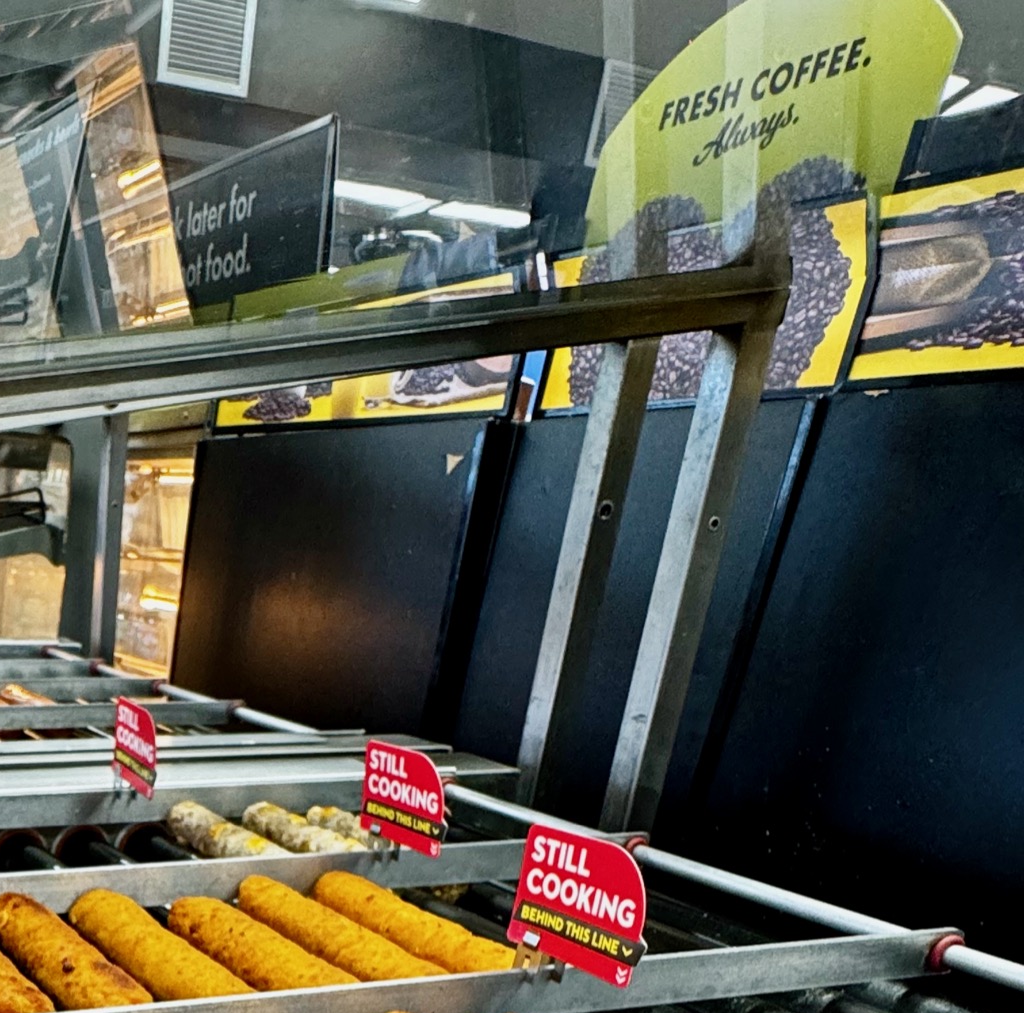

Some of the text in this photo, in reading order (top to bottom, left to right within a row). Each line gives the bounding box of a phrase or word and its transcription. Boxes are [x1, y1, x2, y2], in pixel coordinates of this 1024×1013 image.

[658, 37, 871, 131] FRESH COFFEE.
[692, 103, 800, 167] Always.
[186, 200, 227, 238] later
[228, 182, 257, 224] for
[205, 232, 251, 283] food.
[118, 704, 140, 732] STILL
[116, 725, 154, 763] COOKING
[369, 748, 408, 779] STILL
[368, 773, 438, 815] COOKING
[367, 802, 431, 835] BEHIND THIS LINE
[531, 835, 591, 878] STILL
[526, 868, 636, 928] COOKING
[521, 905, 620, 956] BEHIND THIS LINE
